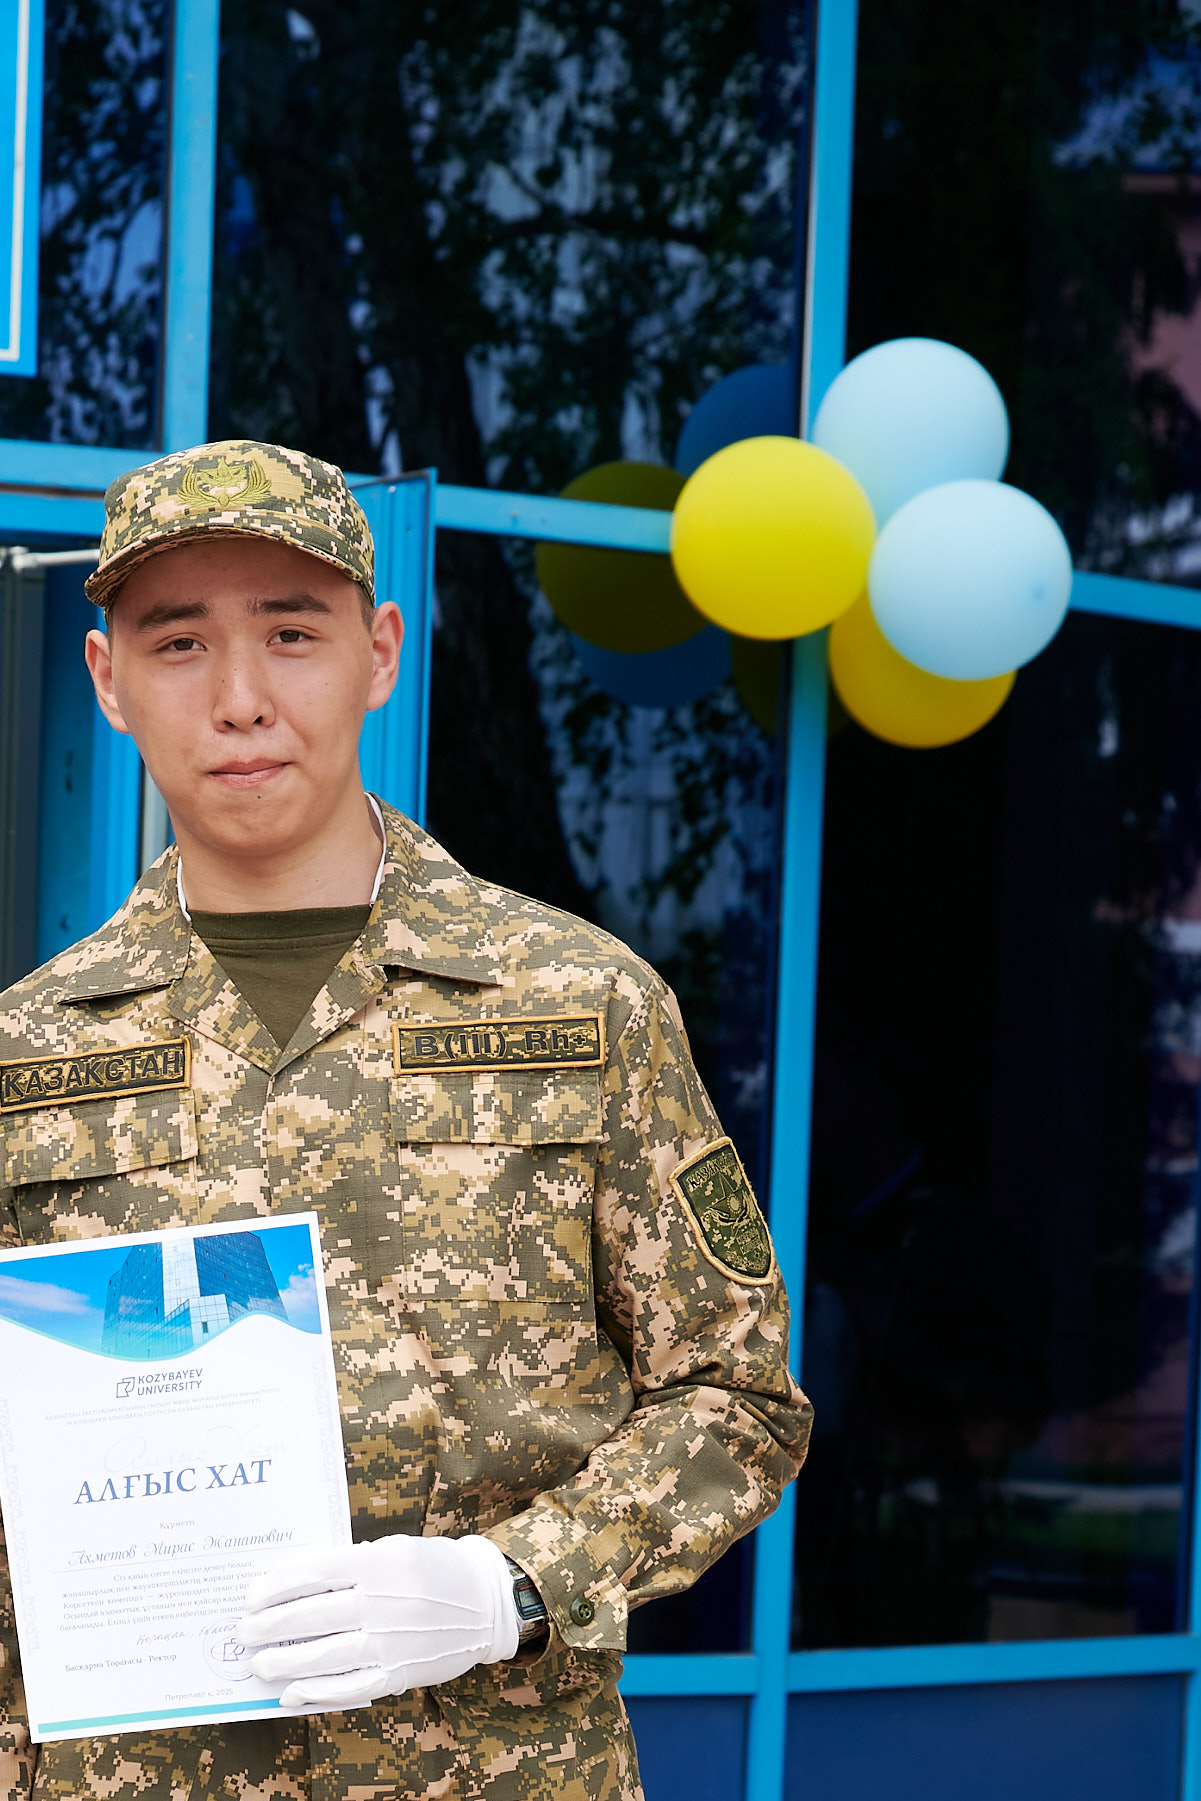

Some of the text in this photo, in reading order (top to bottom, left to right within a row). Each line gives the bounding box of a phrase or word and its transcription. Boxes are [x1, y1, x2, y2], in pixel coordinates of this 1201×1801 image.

[138, 1369, 202, 1384] KOZYBAYEV
[138, 1380, 202, 1395] UNIVERSITY
[73, 1459, 271, 1504] АЛҒЫС ХАТ
[68, 1529, 292, 1566] Ахметов Мирас Жанатович
[149, 1655, 176, 1663] Ректор
